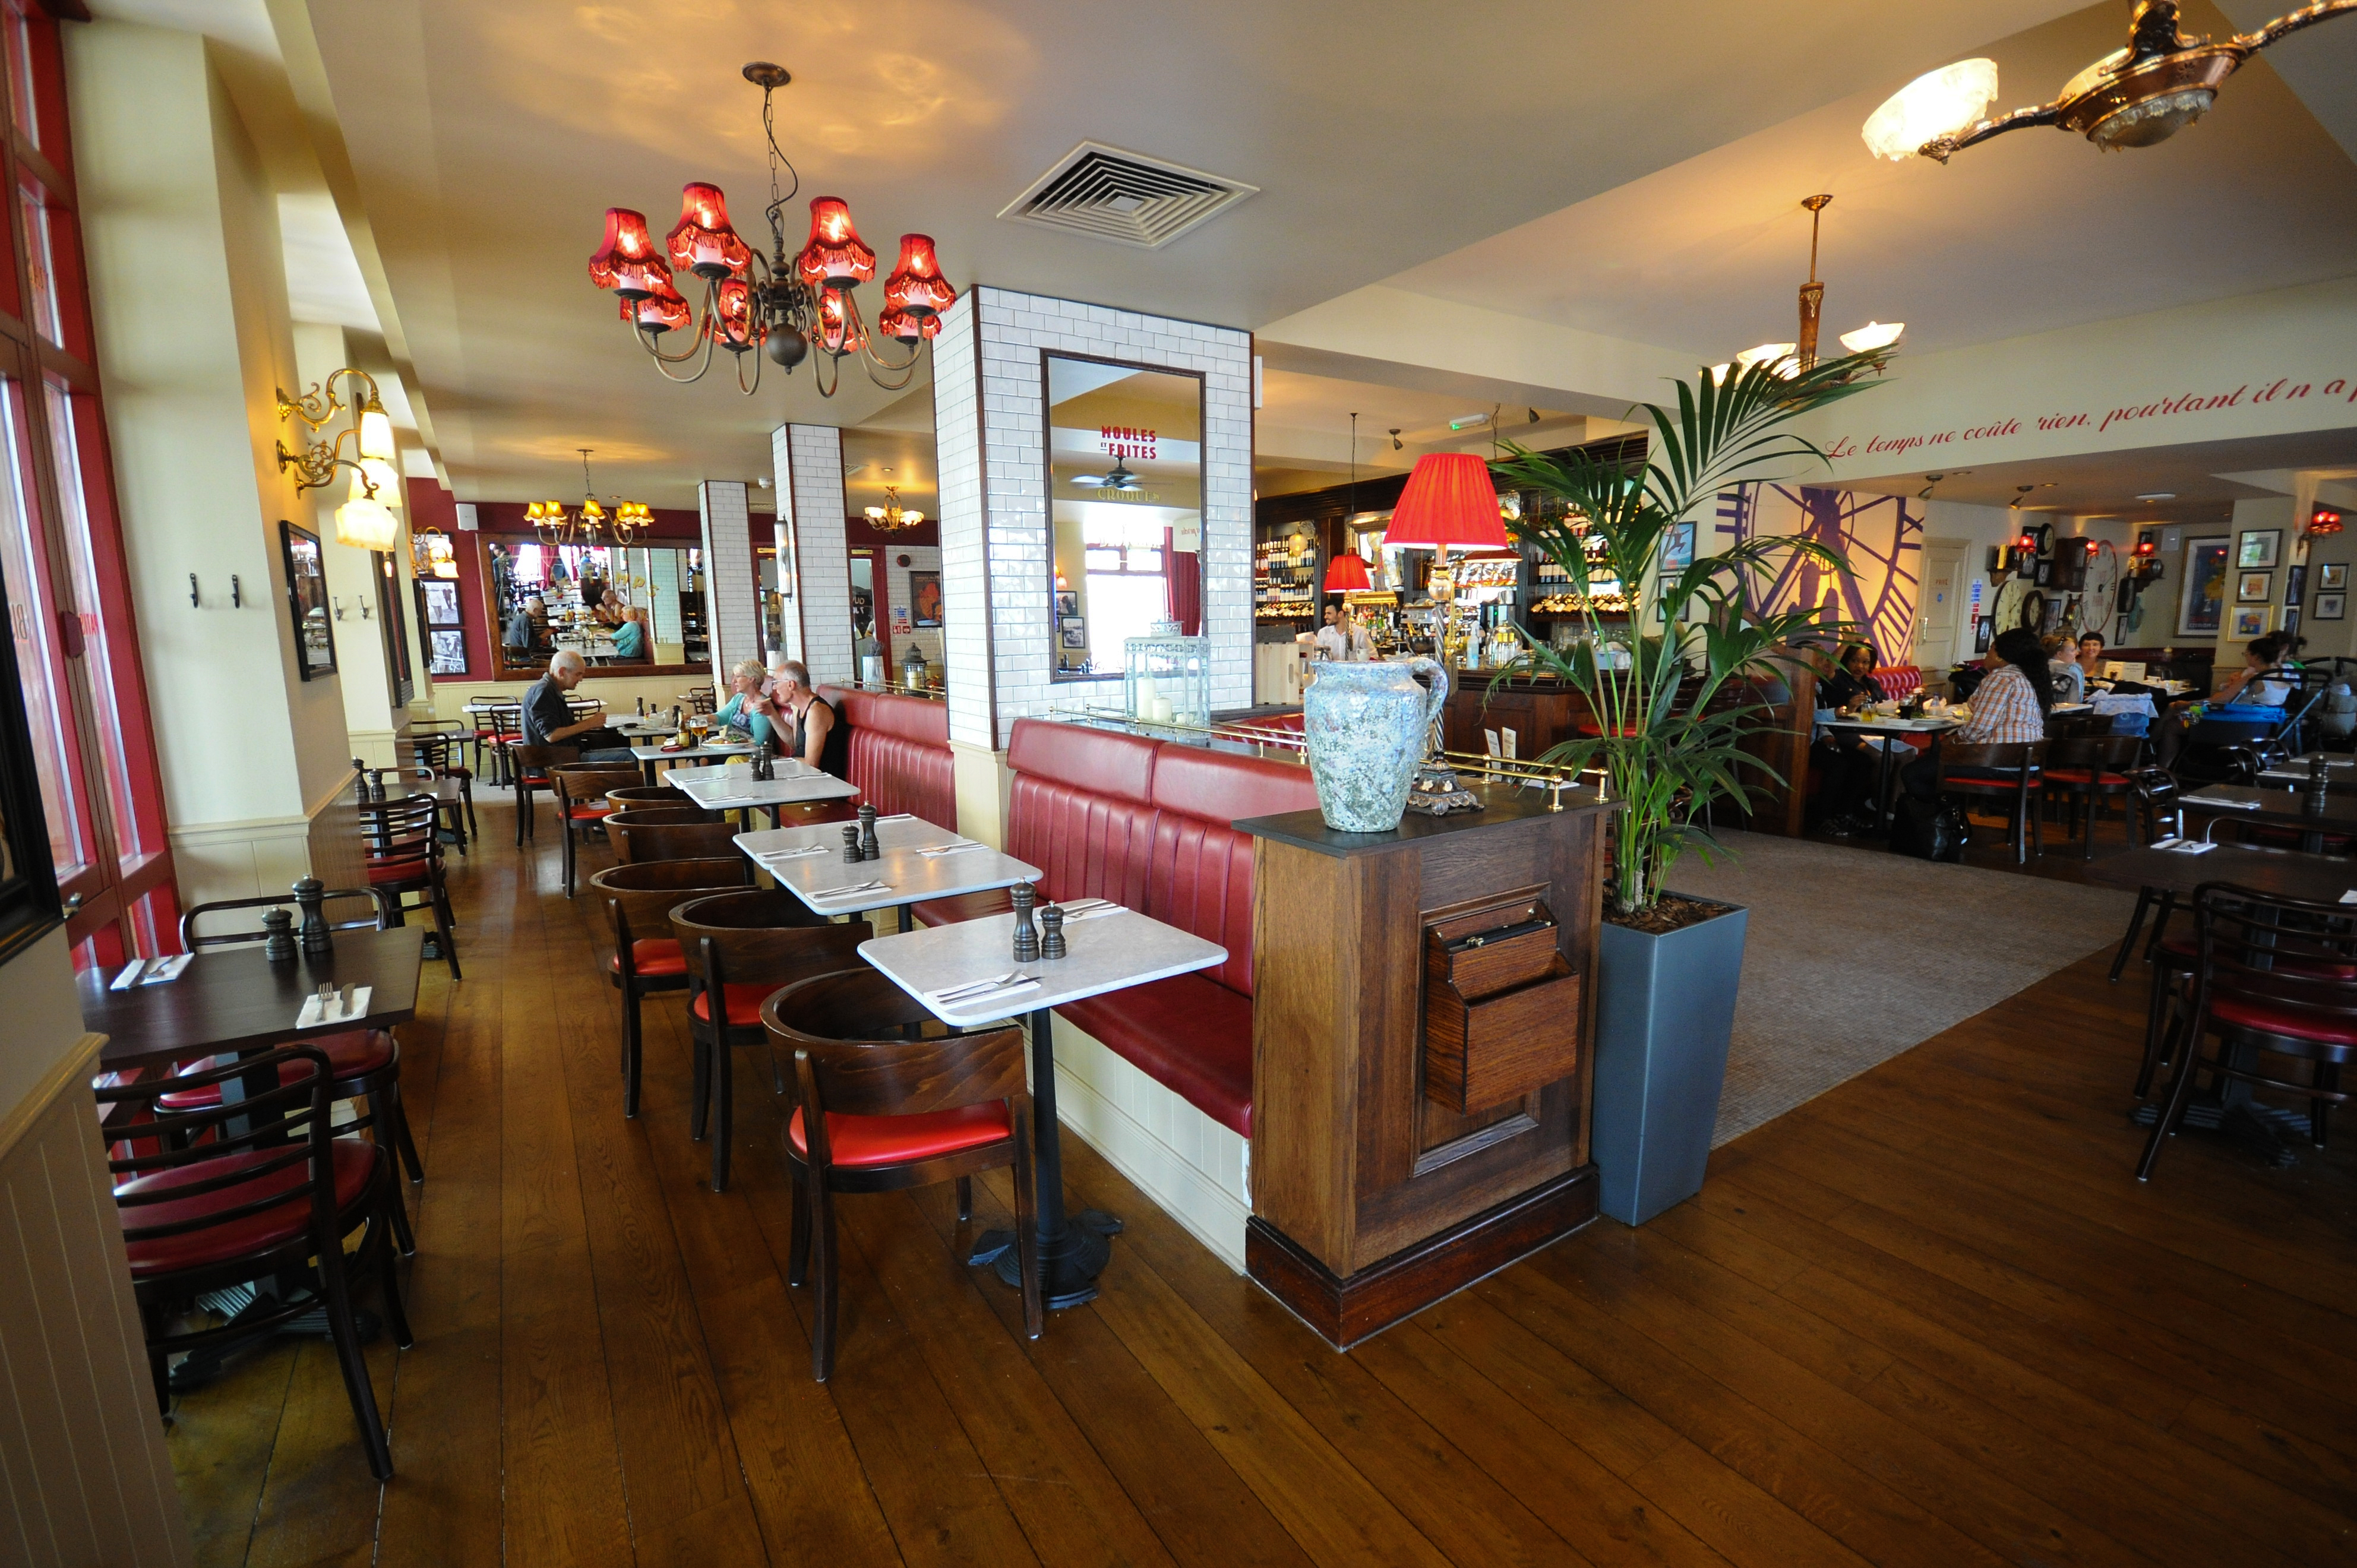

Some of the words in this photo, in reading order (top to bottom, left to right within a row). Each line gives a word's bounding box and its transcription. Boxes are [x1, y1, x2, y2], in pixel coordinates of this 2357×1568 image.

[1825, 436, 1857, 459] Le
[1866, 435, 1923, 456] temps
[1929, 431, 1956, 446] ne
[1963, 418, 2022, 440] coûte
[2099, 384, 2248, 432] pourtant
[2324, 379, 2346, 394] a
[1101, 425, 1157, 442] MOULES
[1108, 443, 1157, 459] FRITES
[1097, 489, 1161, 502] CROQUES
[584, 570, 660, 599] TEMPS
